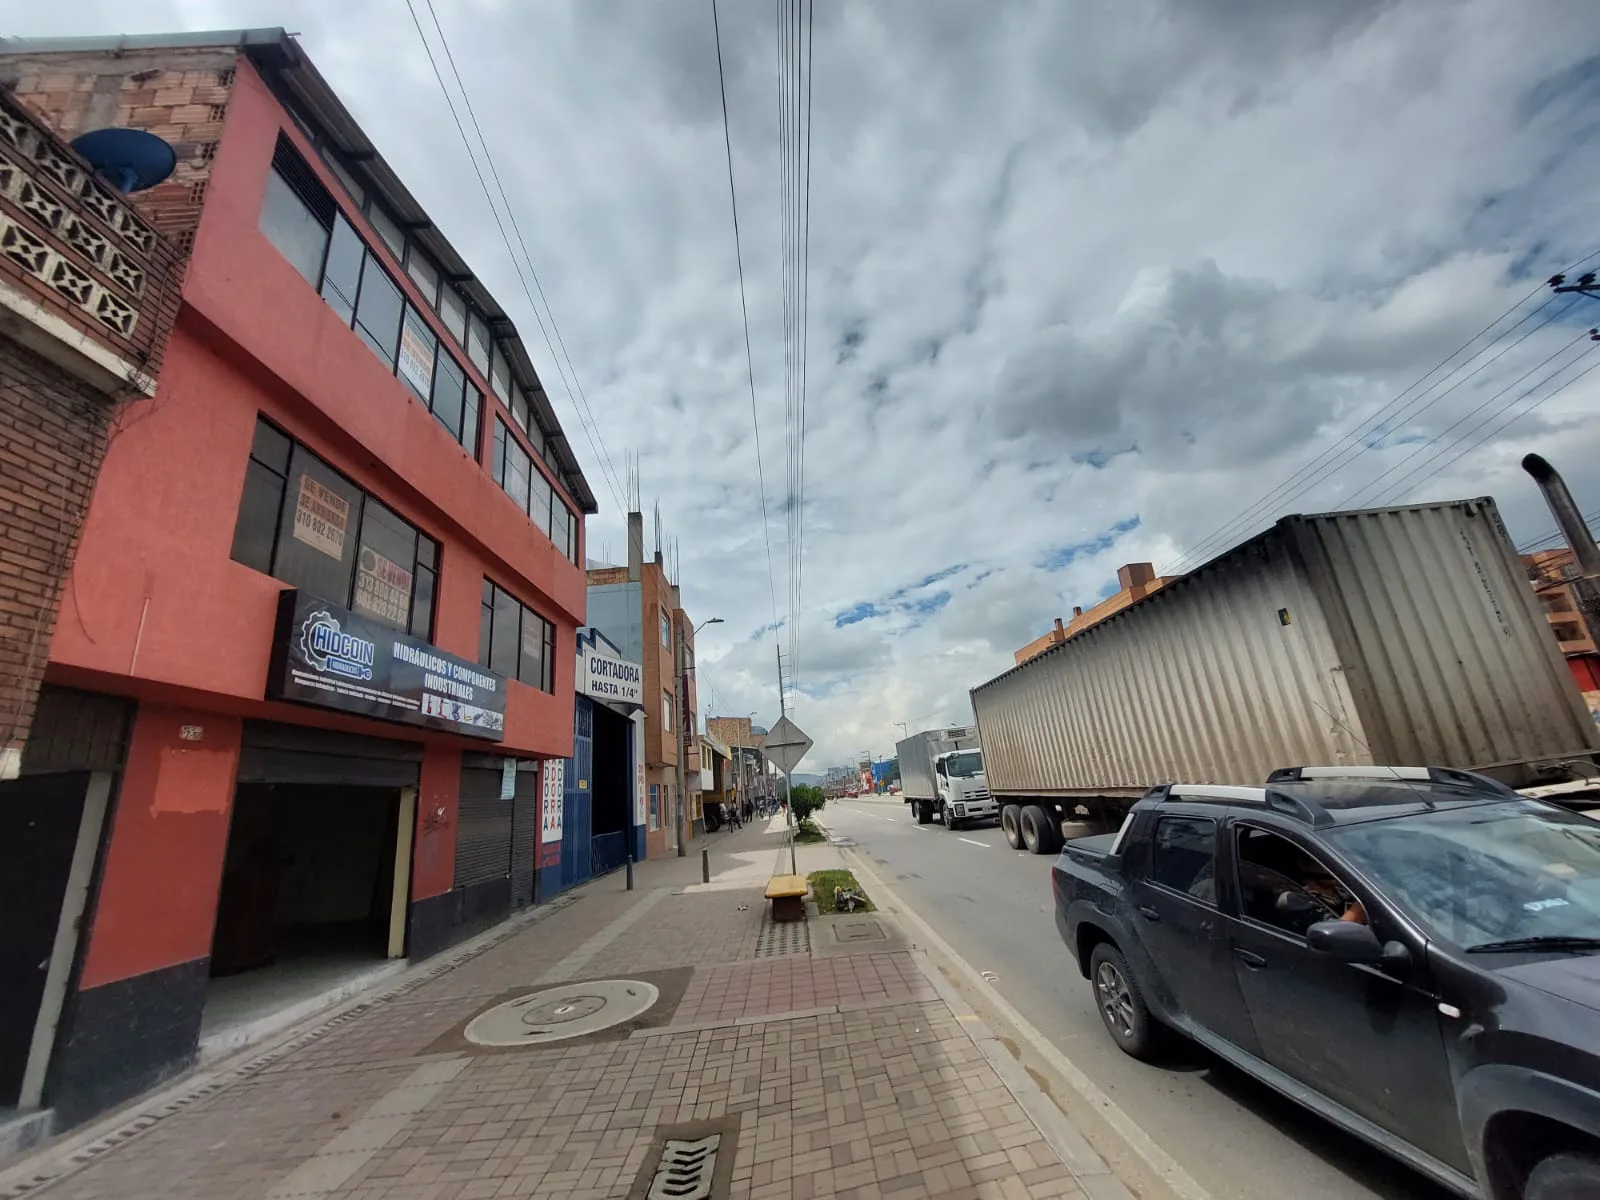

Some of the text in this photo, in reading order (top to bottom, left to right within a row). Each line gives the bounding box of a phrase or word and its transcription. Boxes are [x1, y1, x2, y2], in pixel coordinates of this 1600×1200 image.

[303, 479, 317, 493] SE
[296, 508, 311, 528] 310
[313, 622, 375, 667] HIDCOIN
[393, 641, 447, 675] HIDRÁULICOS
[447, 661, 453, 677] Y
[453, 664, 496, 692] COMPONENTES
[590, 657, 640, 684] CORTADORA
[424, 672, 474, 701] INDUSTRIALES
[591, 680, 638, 698] HASTA 1/4"
